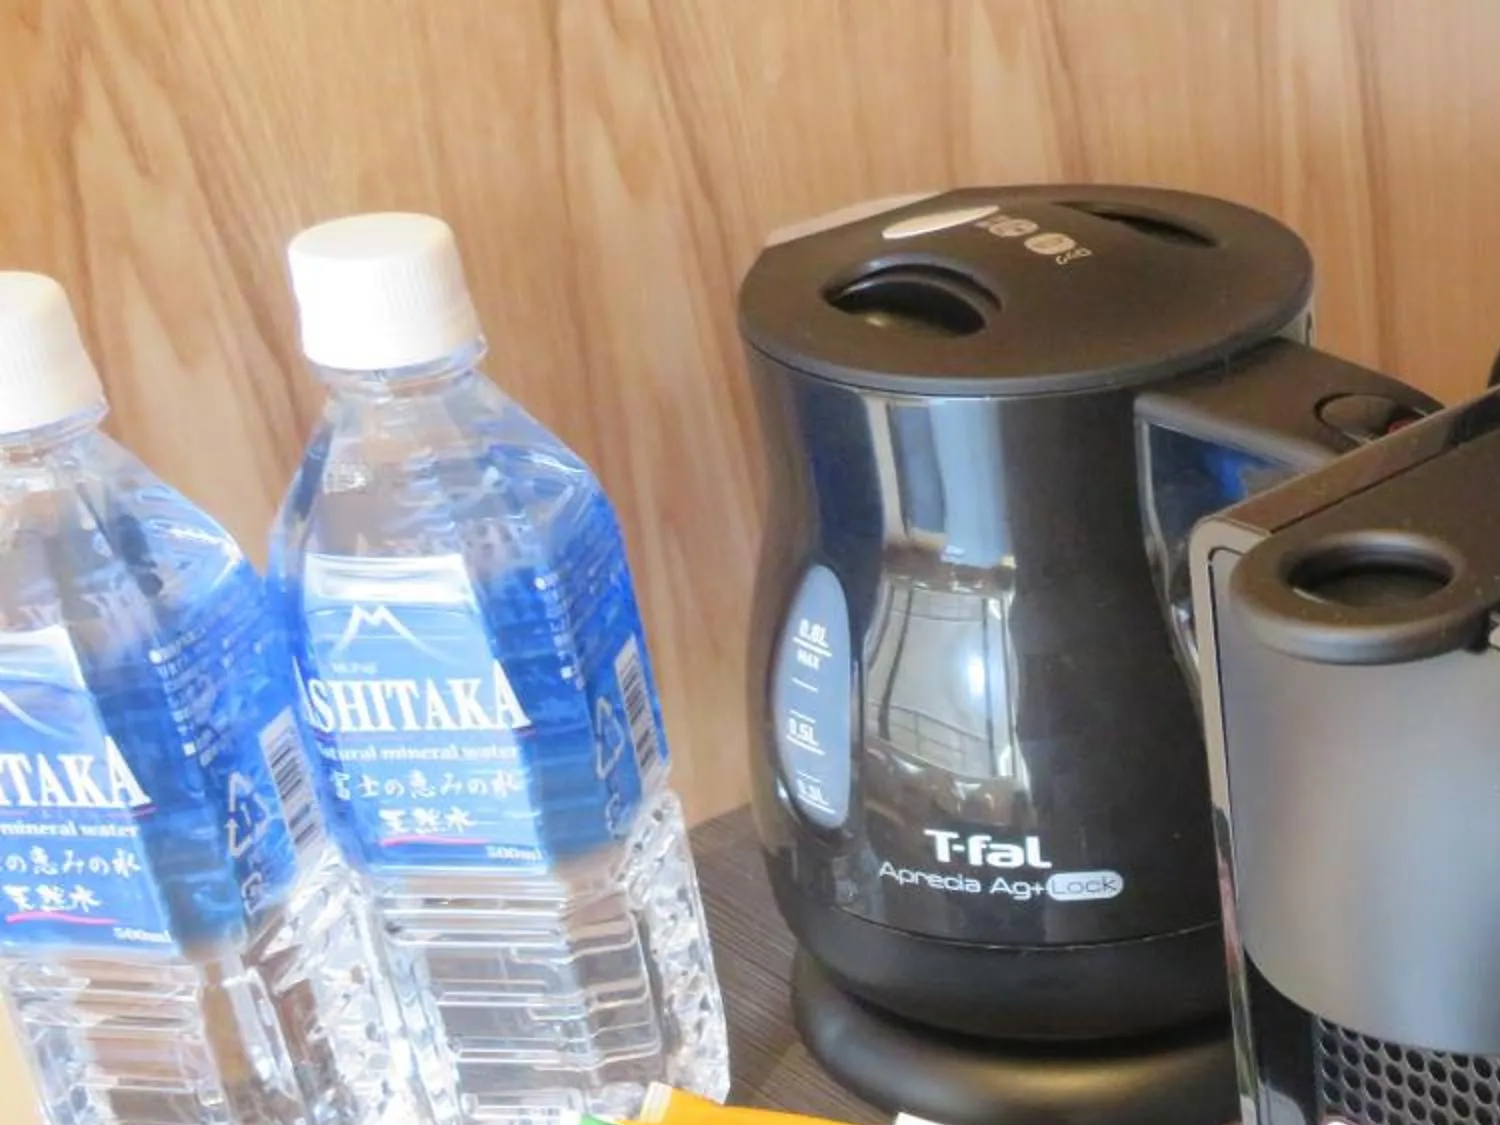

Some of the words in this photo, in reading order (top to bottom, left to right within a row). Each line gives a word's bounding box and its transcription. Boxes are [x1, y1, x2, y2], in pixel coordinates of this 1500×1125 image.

[0, 736, 153, 809] TAKA
[0, 845, 142, 878] の恵みの水
[924, 828, 1053, 868] T-fal
